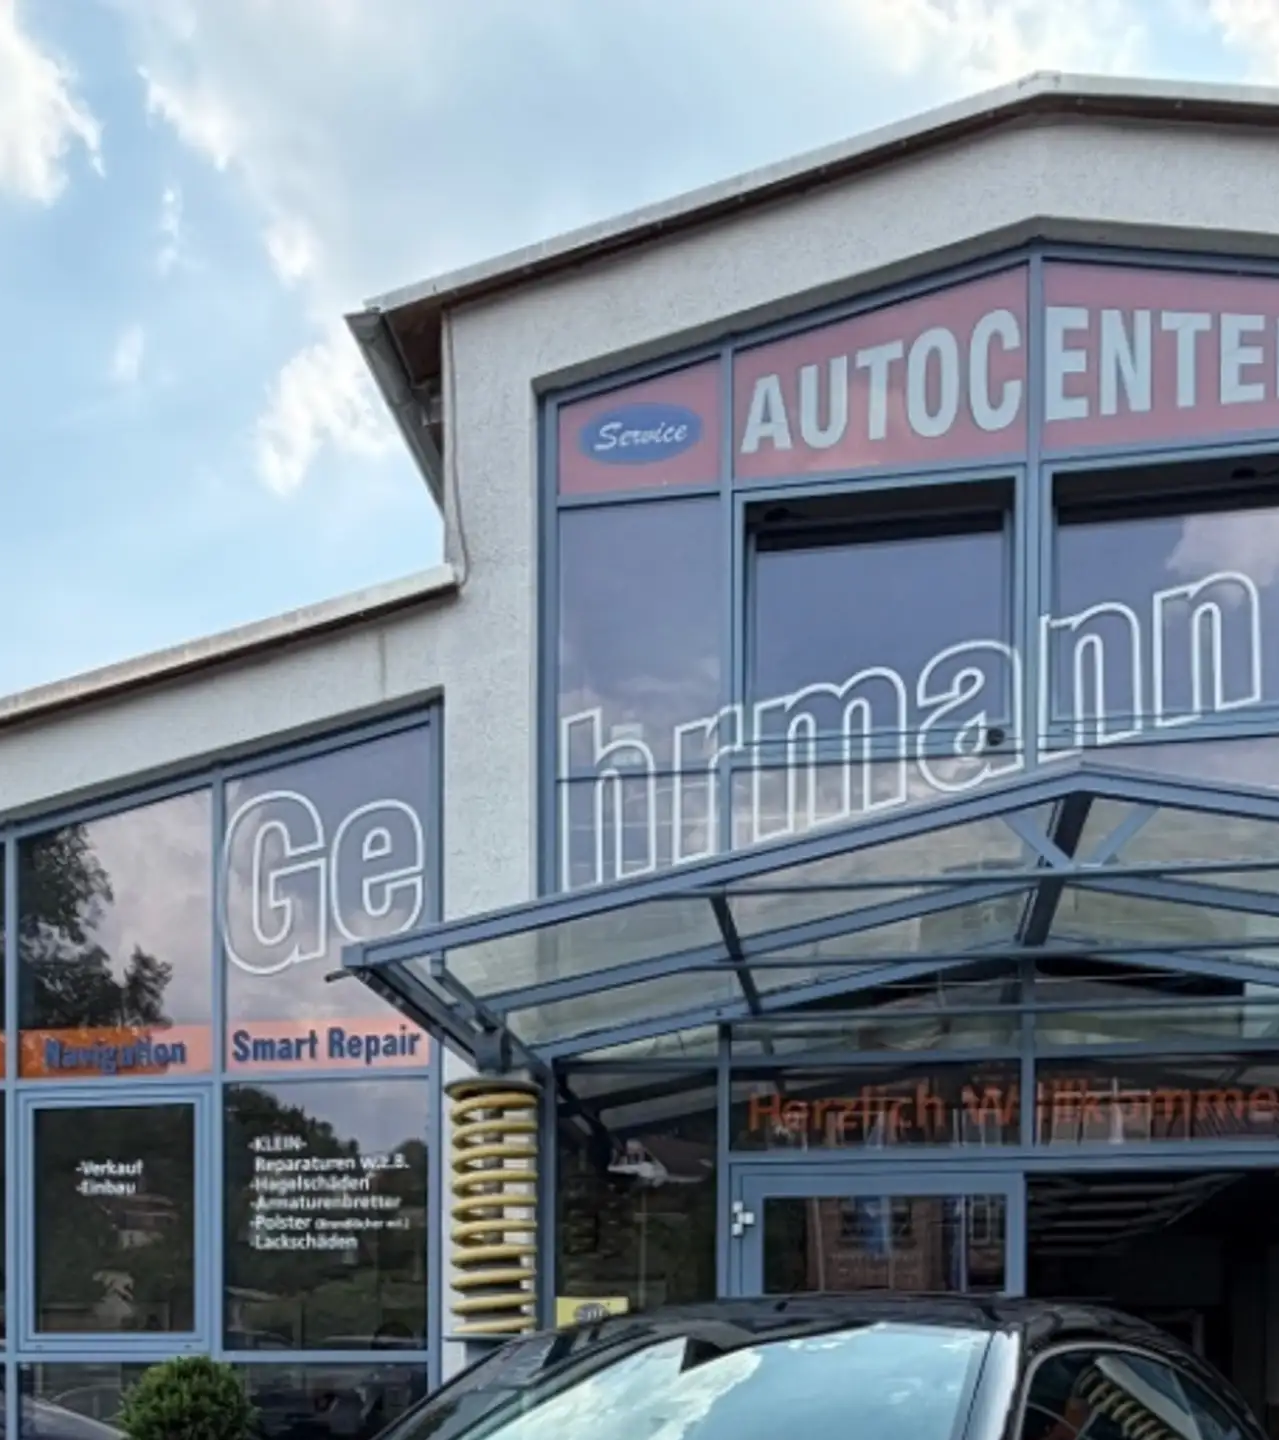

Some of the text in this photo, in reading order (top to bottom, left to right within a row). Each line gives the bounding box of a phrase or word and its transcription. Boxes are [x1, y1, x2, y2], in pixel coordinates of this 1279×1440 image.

[593, 420, 689, 452] Service
[46, 1036, 187, 1074] Navigation
[232, 1024, 421, 1065] Smart Repair
[75, 1158, 144, 1177] -Verkauf
[255, 1157, 356, 1175] Reparaturen
[75, 1178, 137, 1196] -Einbau
